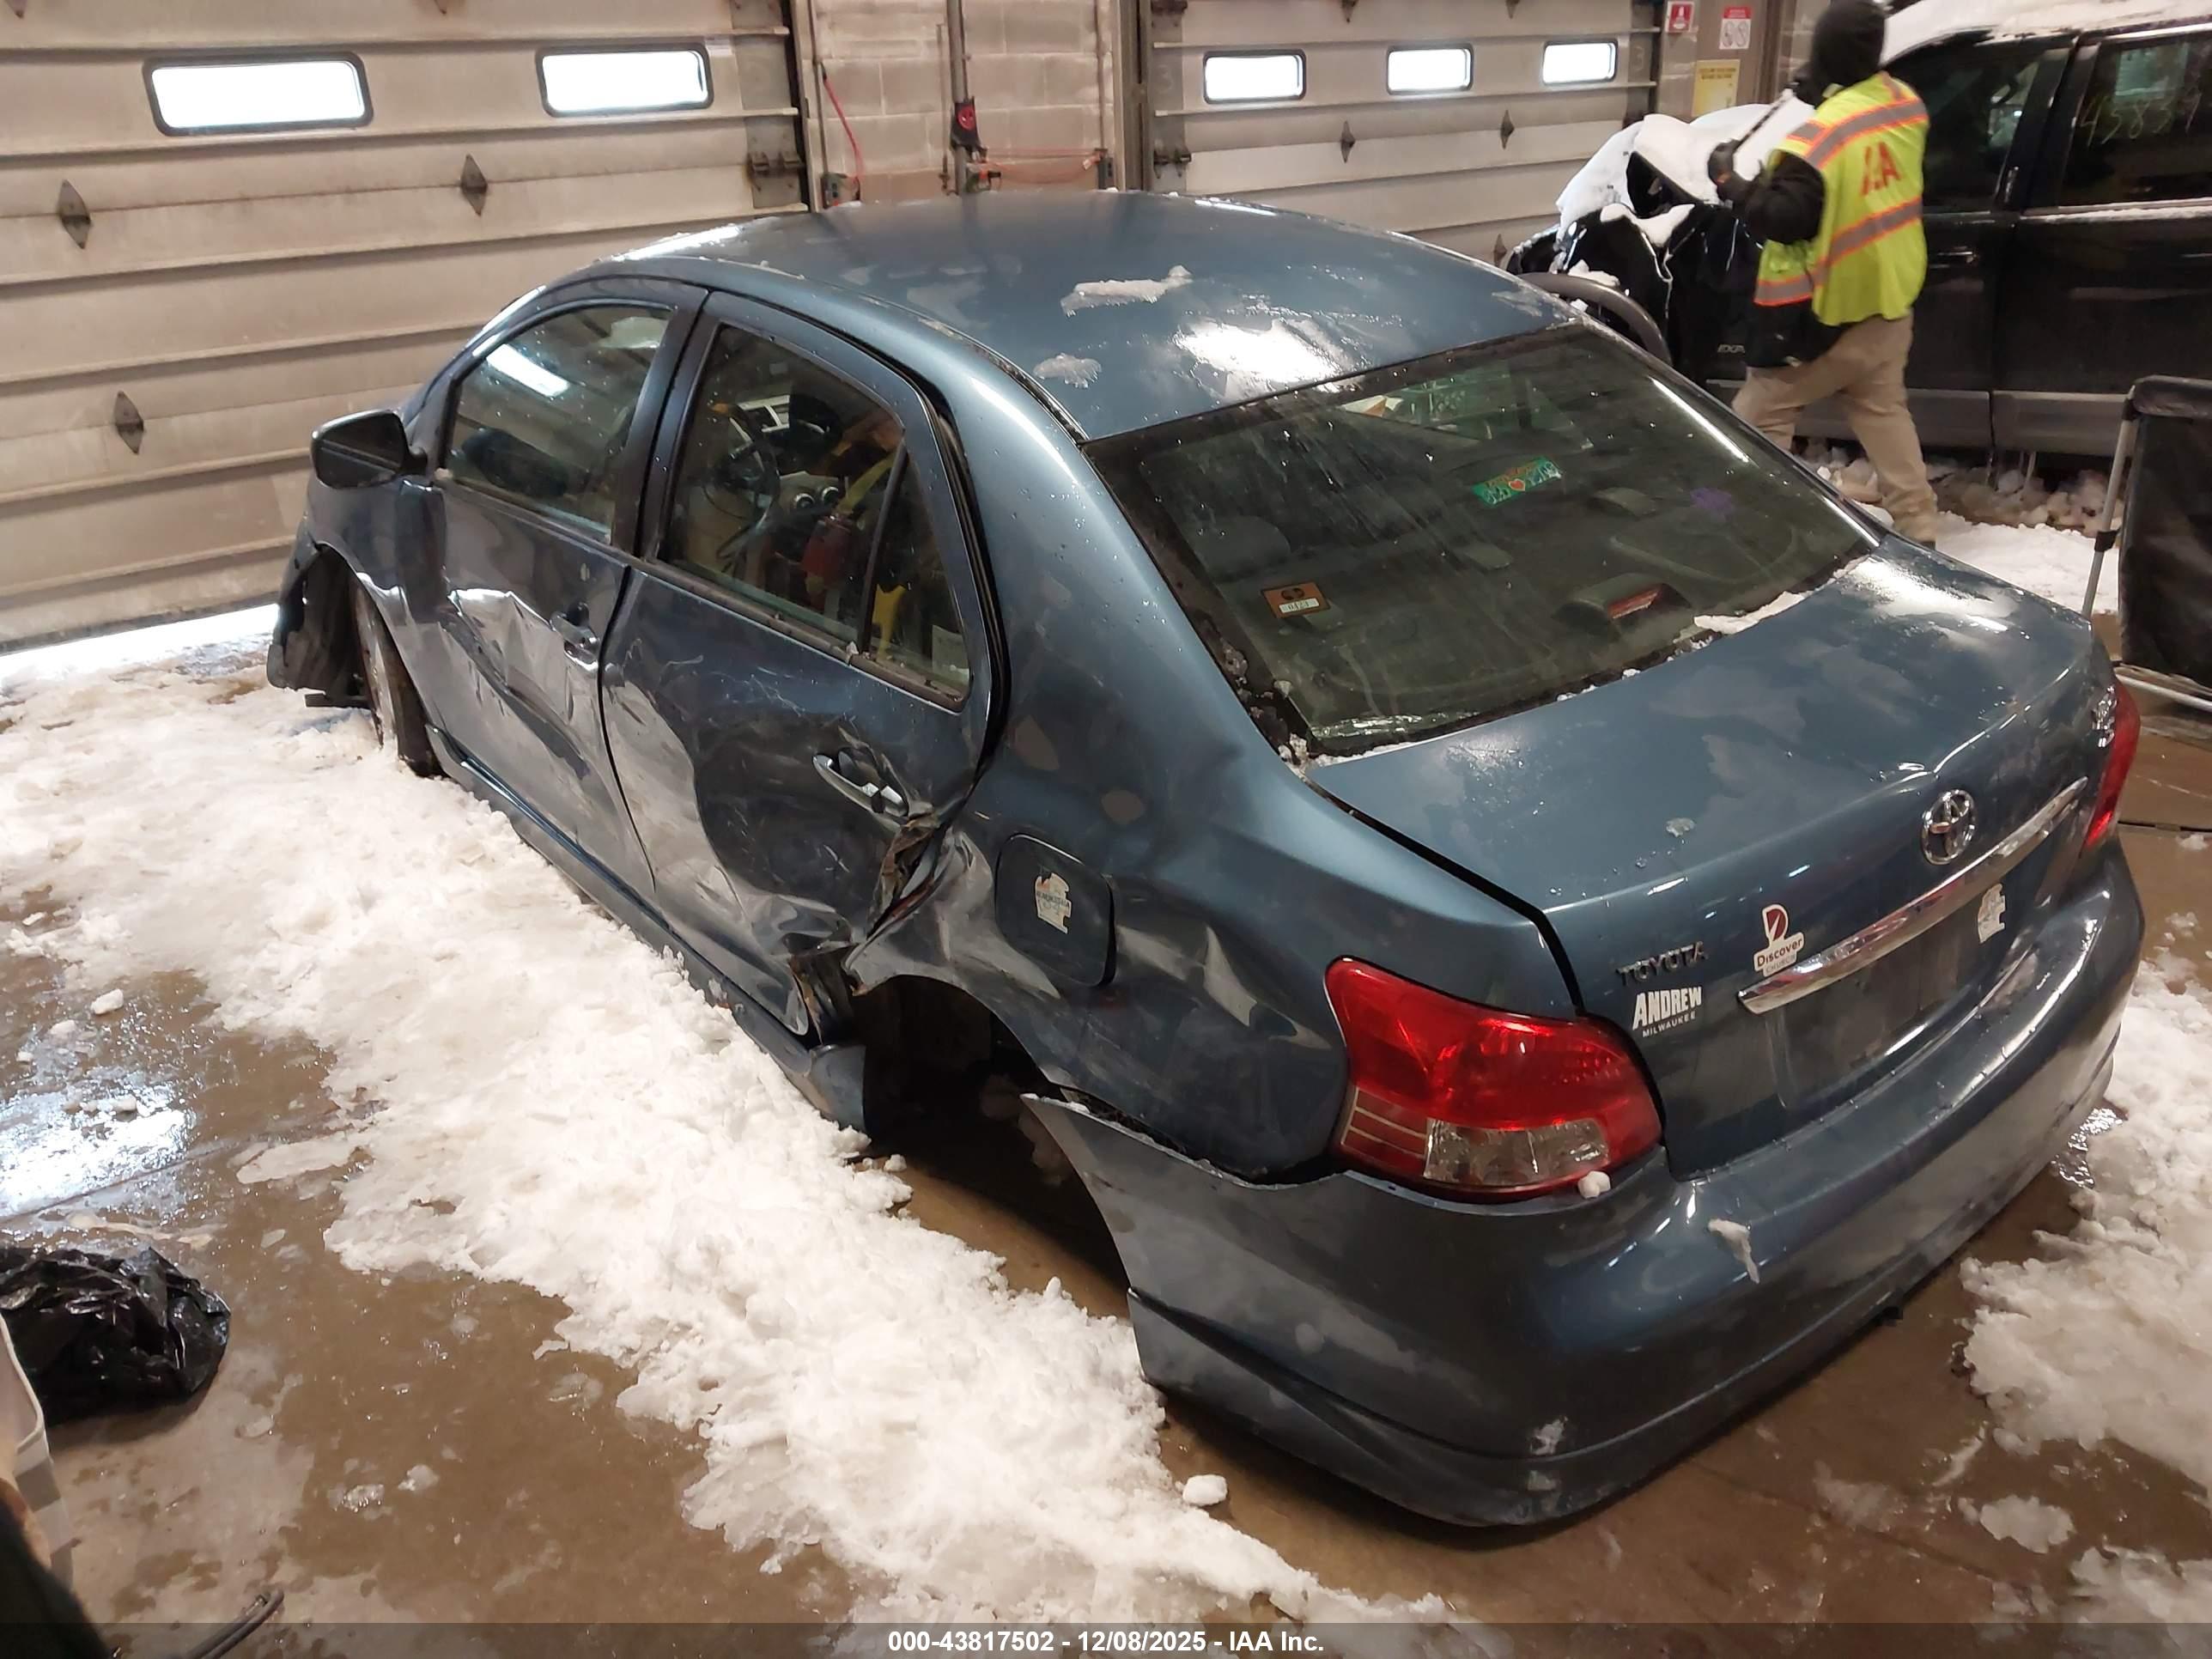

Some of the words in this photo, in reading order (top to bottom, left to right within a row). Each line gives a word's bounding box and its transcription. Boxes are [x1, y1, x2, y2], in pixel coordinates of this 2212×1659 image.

[1615, 941, 1708, 987] TOYOTA
[1757, 938, 1802, 968] Discover
[1632, 986, 1702, 1030] ANDREW
[1642, 1011, 1696, 1037] MILWAUKEE
